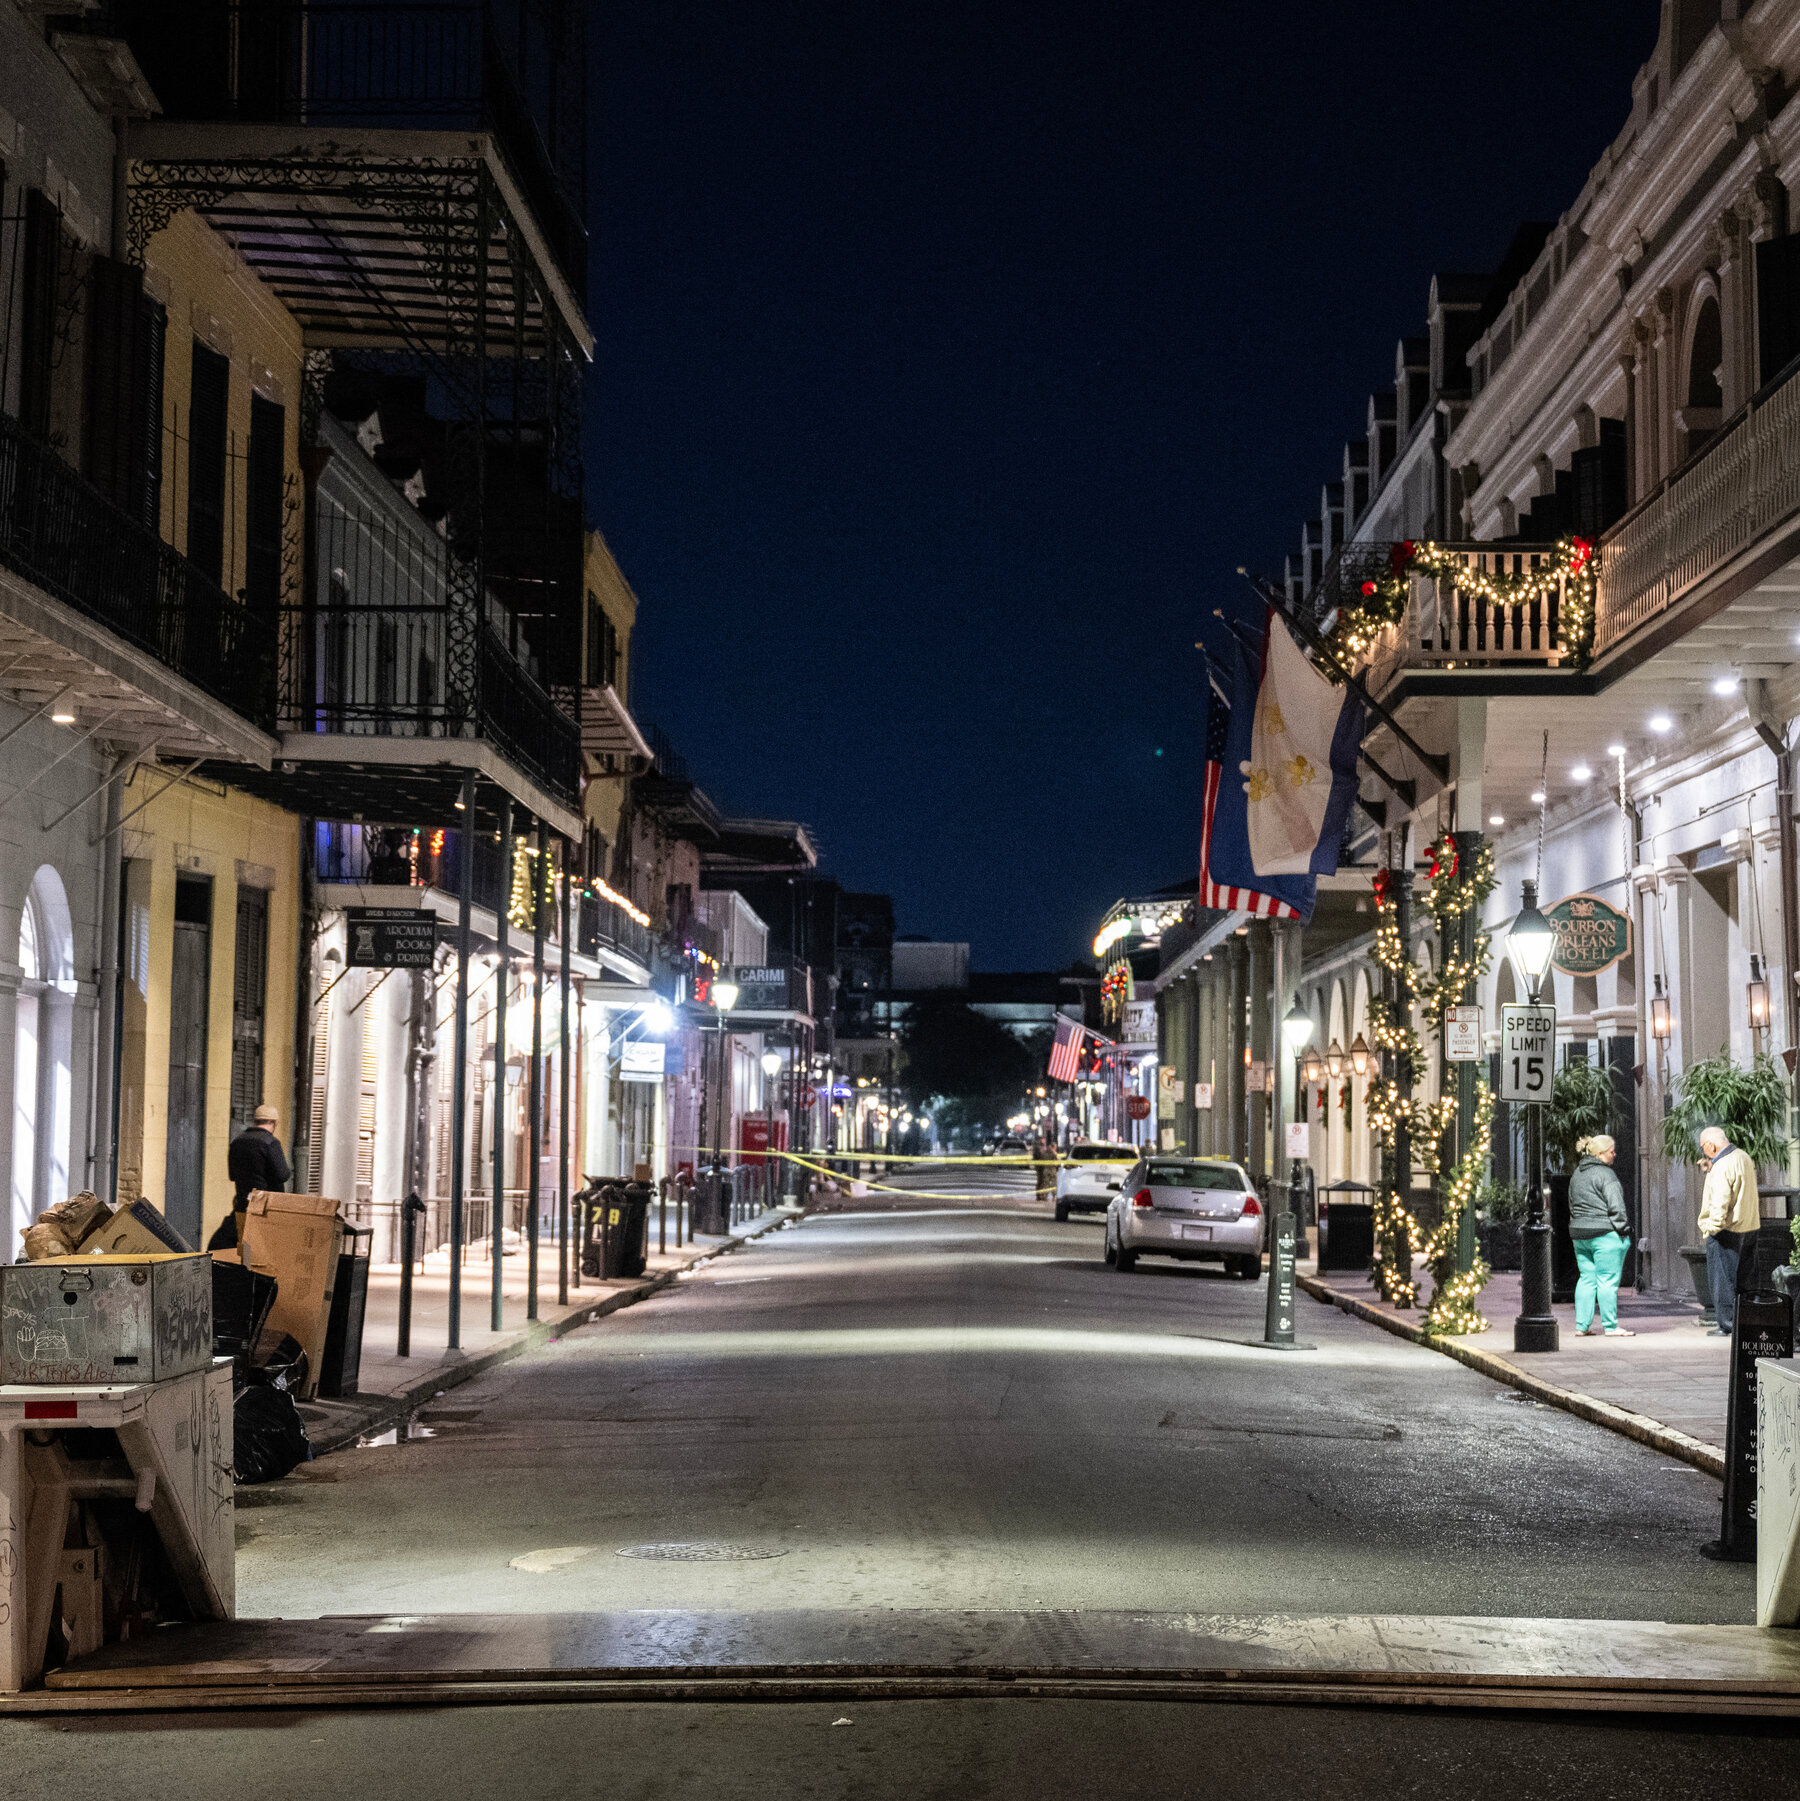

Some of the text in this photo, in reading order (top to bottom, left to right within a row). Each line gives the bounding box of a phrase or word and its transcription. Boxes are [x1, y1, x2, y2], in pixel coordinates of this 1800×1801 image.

[385, 926, 433, 936] ARCADIAN
[1549, 918, 1616, 933] BOURBON
[396, 939, 432, 950] BOOKS
[397, 953, 431, 963] PRINTS
[1555, 947, 1609, 960] HOTEL
[740, 969, 785, 982] CARIMI
[1447, 1010, 1456, 1020] NO
[1507, 1017, 1552, 1032] SPEED
[1511, 1036, 1546, 1052] LIMIT
[1511, 1056, 1544, 1091] 15
[1128, 1102, 1149, 1113] STOP
[1741, 1341, 1786, 1352] BOURBON
